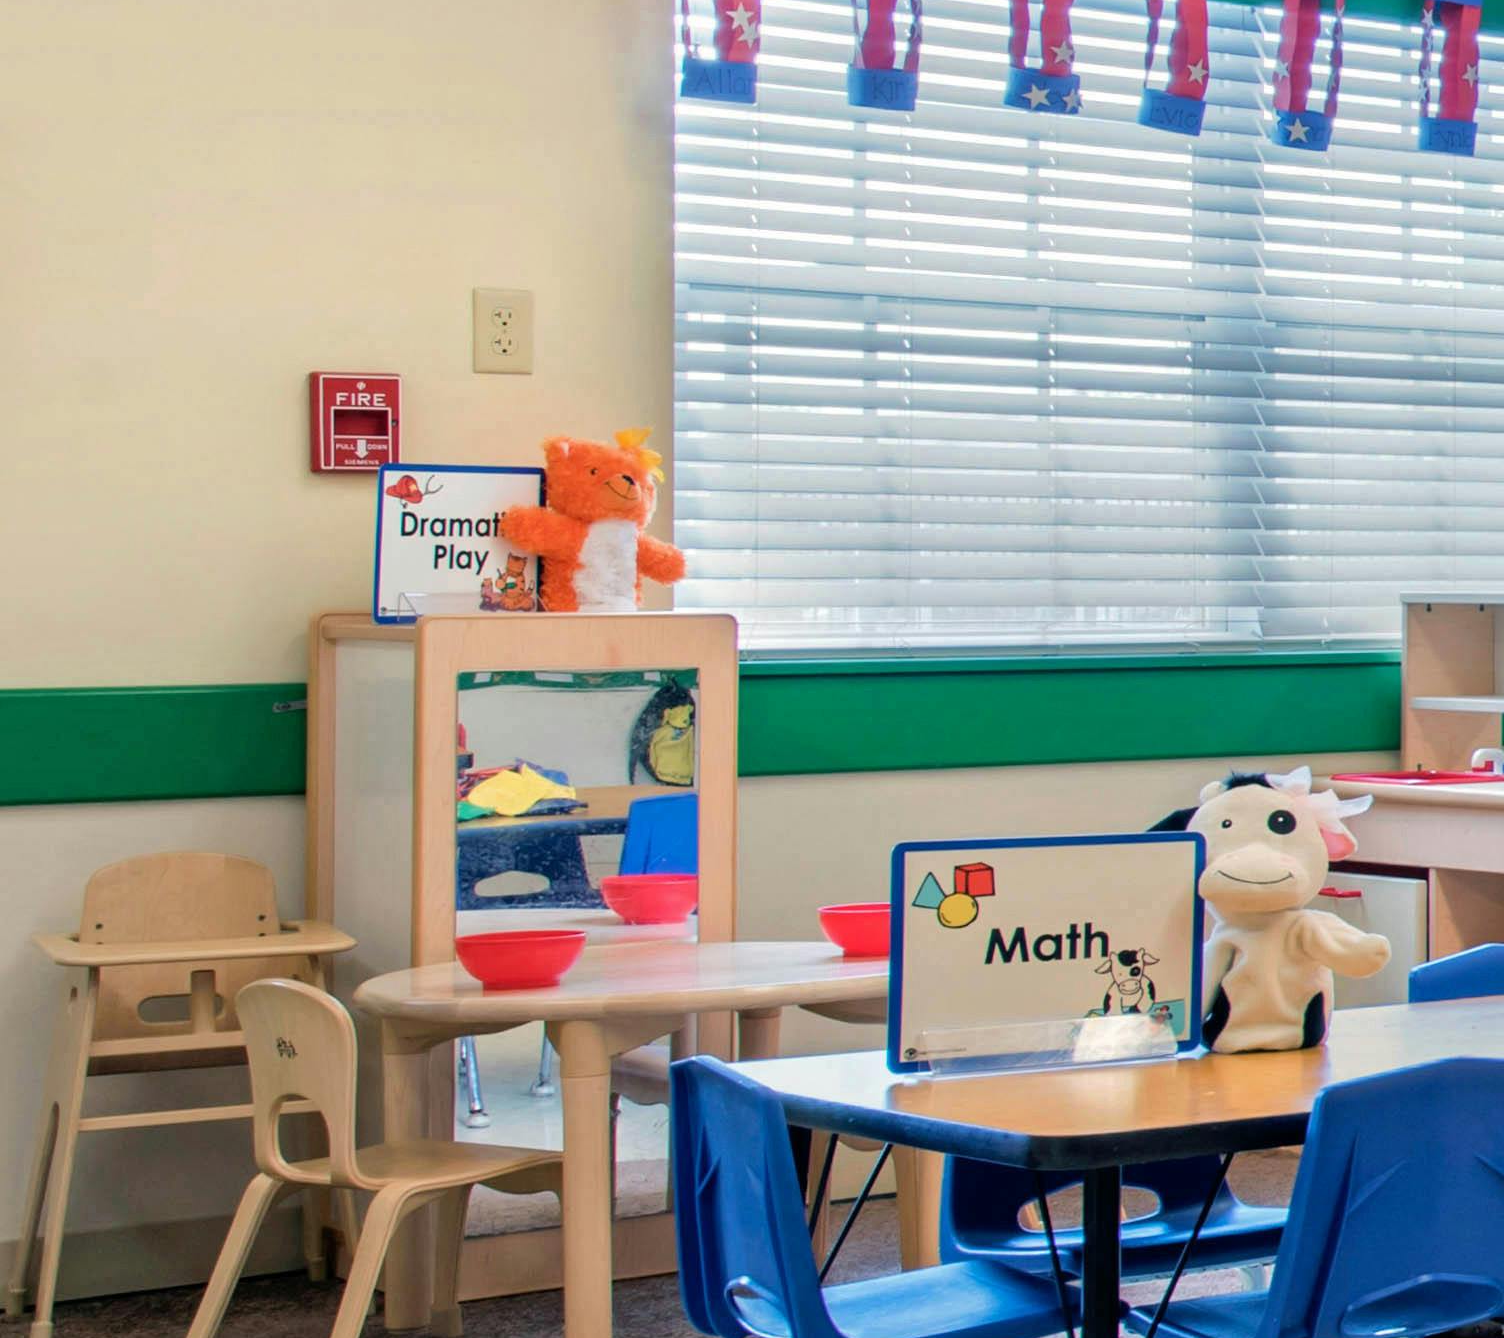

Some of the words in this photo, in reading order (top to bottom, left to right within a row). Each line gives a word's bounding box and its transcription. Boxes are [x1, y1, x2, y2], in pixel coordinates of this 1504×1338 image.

[335, 392, 387, 407] FIRE
[335, 443, 356, 451] PULL
[366, 443, 388, 451] DOWN
[433, 543, 490, 576] Play
[983, 921, 1110, 965] Math
